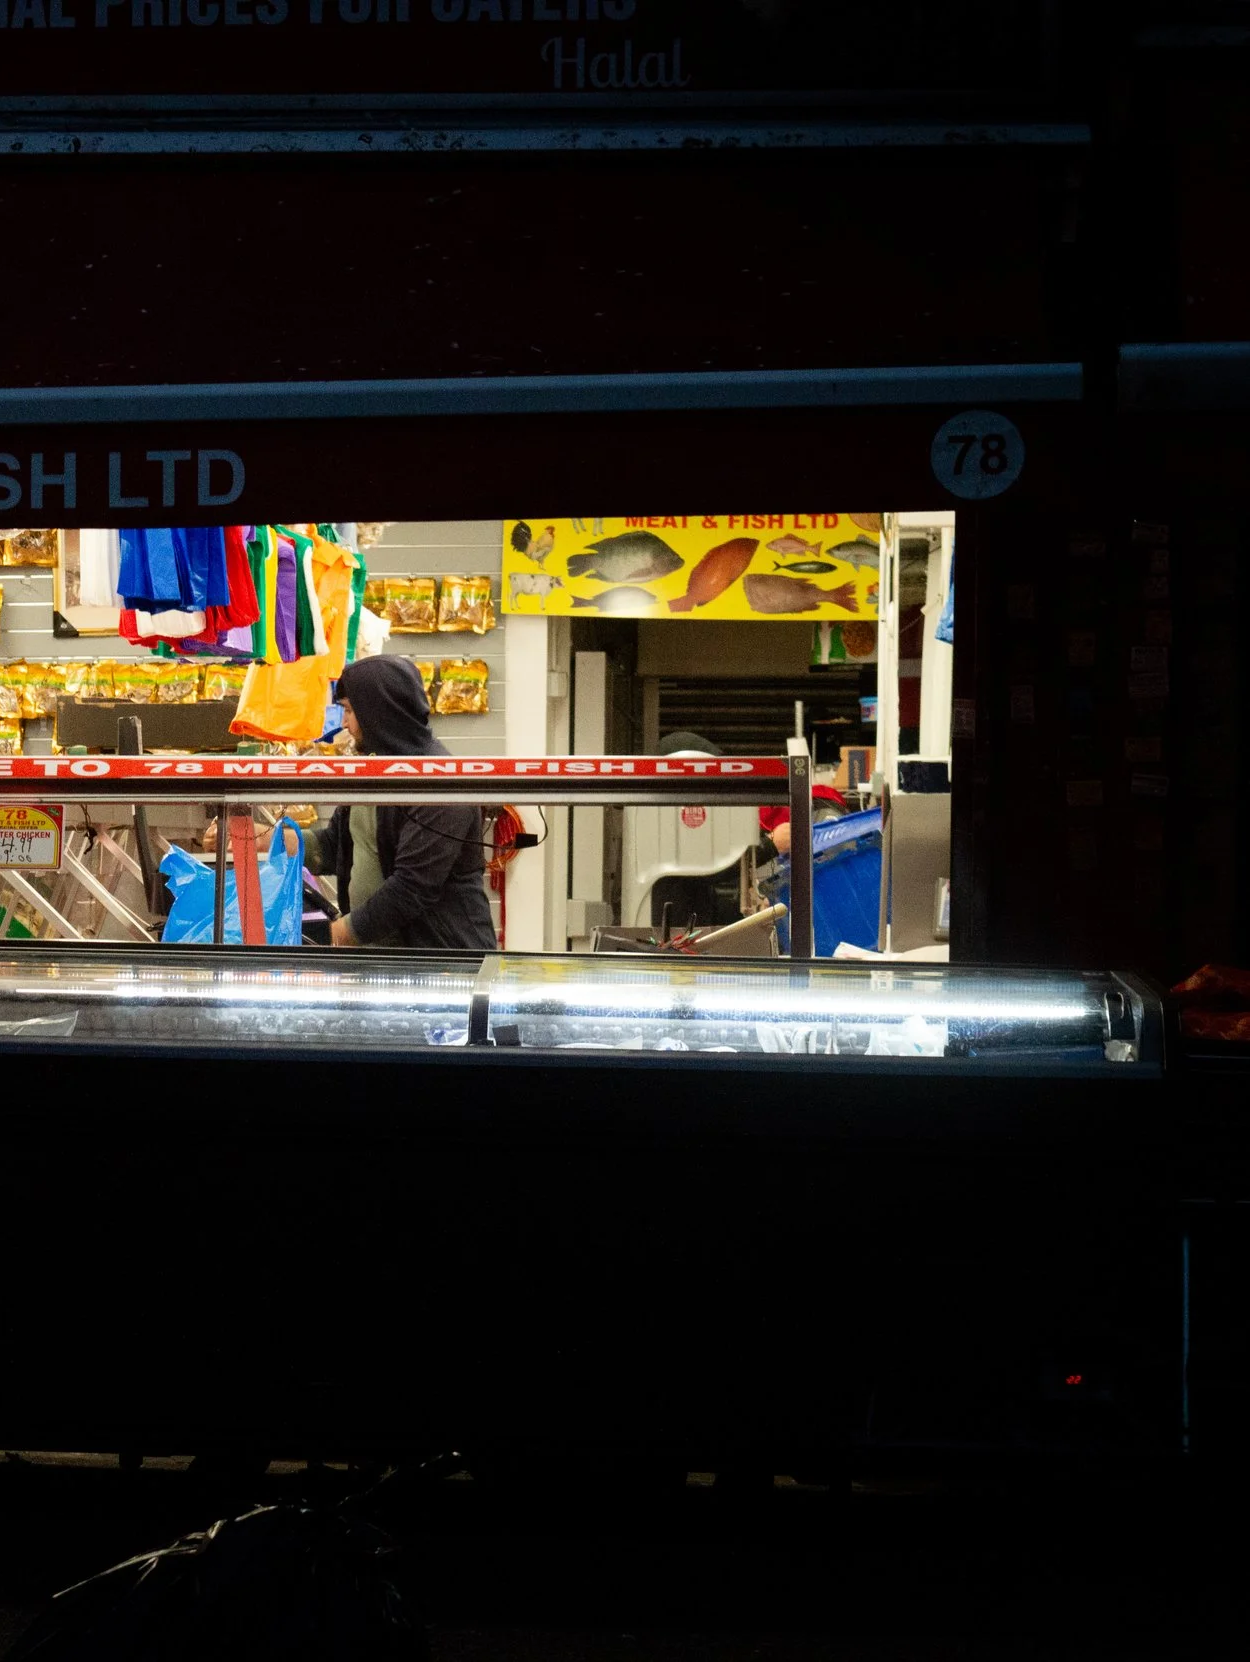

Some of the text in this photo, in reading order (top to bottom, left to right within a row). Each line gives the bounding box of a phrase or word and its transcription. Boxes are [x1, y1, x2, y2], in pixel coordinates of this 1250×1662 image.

[540, 36, 691, 89] Halal
[947, 434, 1008, 476] 78
[107, 448, 248, 509] LTD
[625, 514, 840, 529] MEAT & FISH LTD
[33, 759, 111, 777] TO
[144, 762, 204, 774] 78
[223, 762, 367, 774] MEAT
[382, 762, 495, 774] AND
[514, 762, 635, 774] FISH
[655, 762, 754, 774] LTD
[3, 809, 28, 820] 78
[16, 831, 51, 839] CHICKEN
